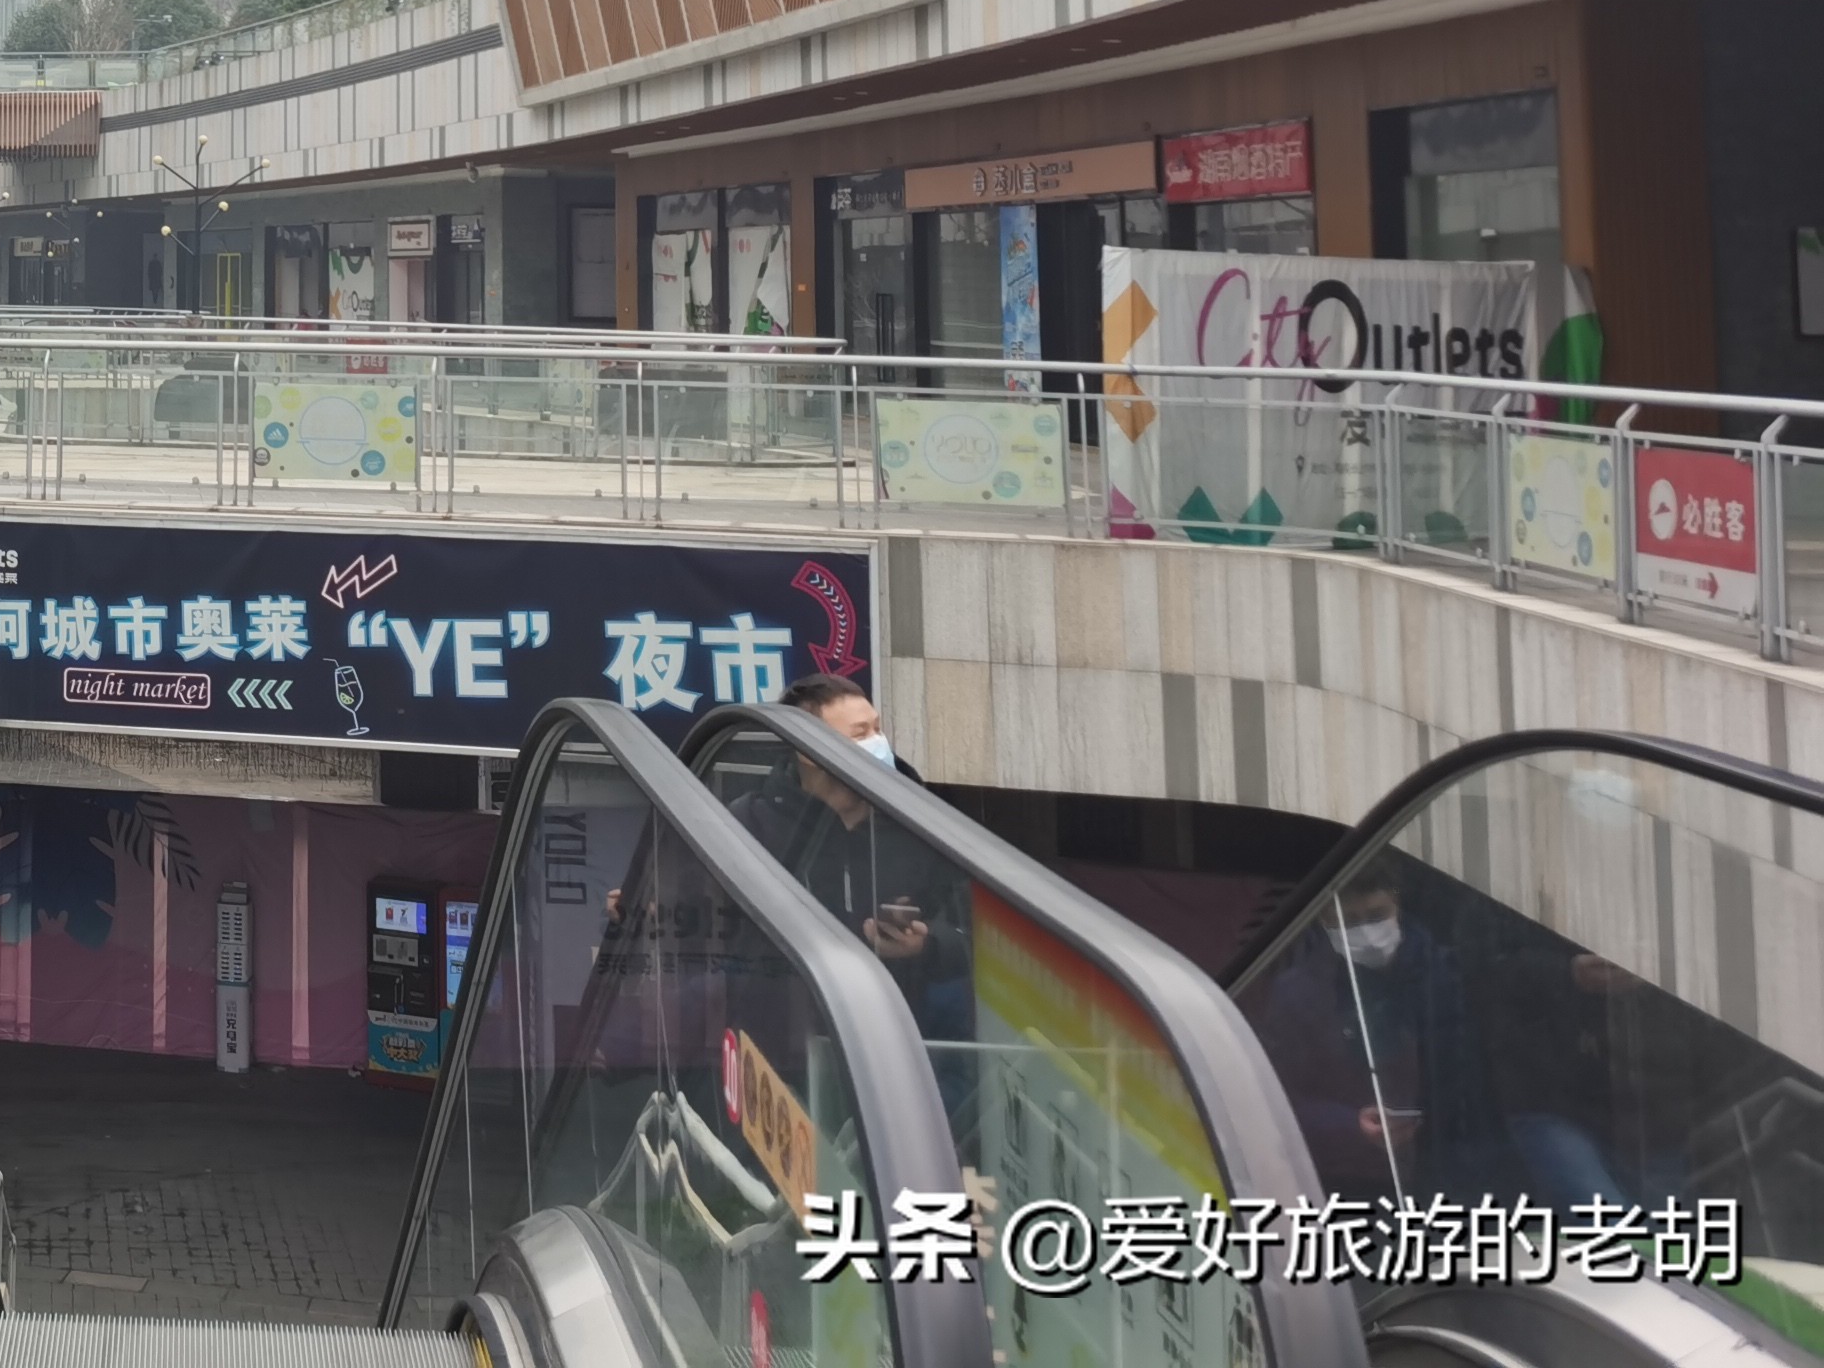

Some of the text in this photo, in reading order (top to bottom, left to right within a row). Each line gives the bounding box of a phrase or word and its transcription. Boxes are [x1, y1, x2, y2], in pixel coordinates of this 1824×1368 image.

[1298, 279, 1525, 393] Outlets
[1682, 494, 1745, 542] 必胜客
[69, 674, 208, 705] night market
[603, 612, 793, 713] 夜市
